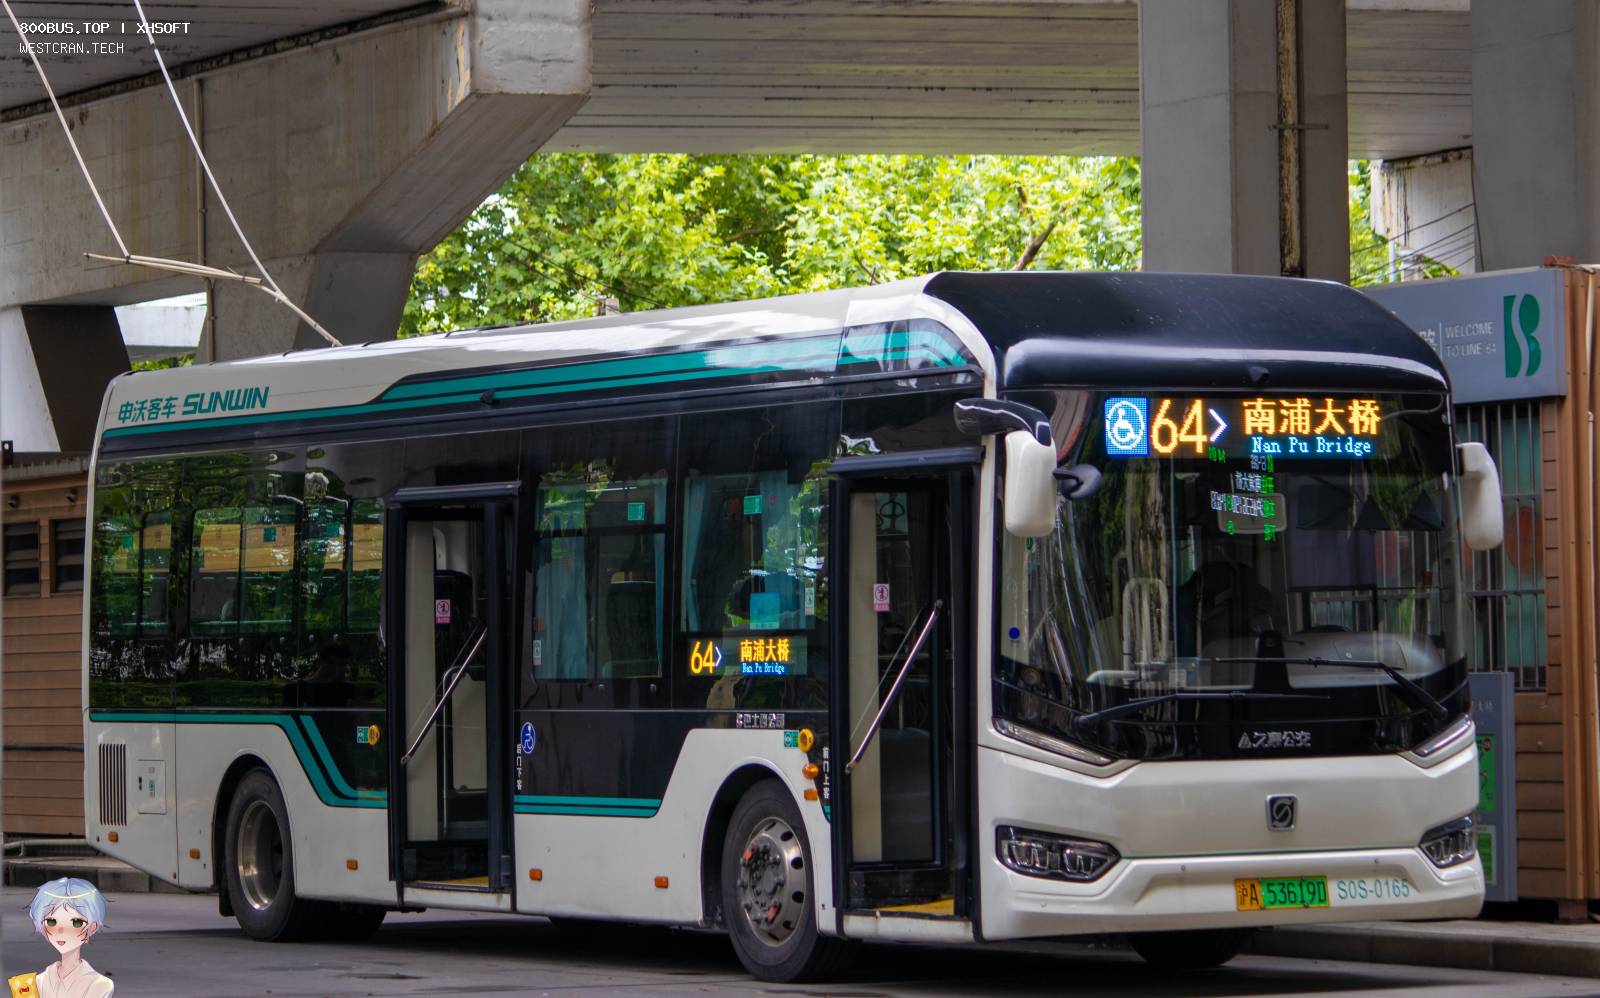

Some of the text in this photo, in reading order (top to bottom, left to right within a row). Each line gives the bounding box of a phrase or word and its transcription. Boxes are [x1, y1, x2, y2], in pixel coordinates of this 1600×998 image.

[1444, 321, 1495, 339] WELCOME
[1445, 345, 1459, 358] TO
[1461, 342, 1482, 357] LINE
[118, 386, 270, 423] 申沃客车 SUNWIN
[1243, 398, 1381, 435] 南浦大桥
[1151, 399, 1208, 453] 64
[1251, 436, 1372, 456] Nan Pu Bridge
[690, 640, 715, 674] 64
[740, 638, 790, 662] 南浦大桥
[764, 662, 785, 675] Bridge
